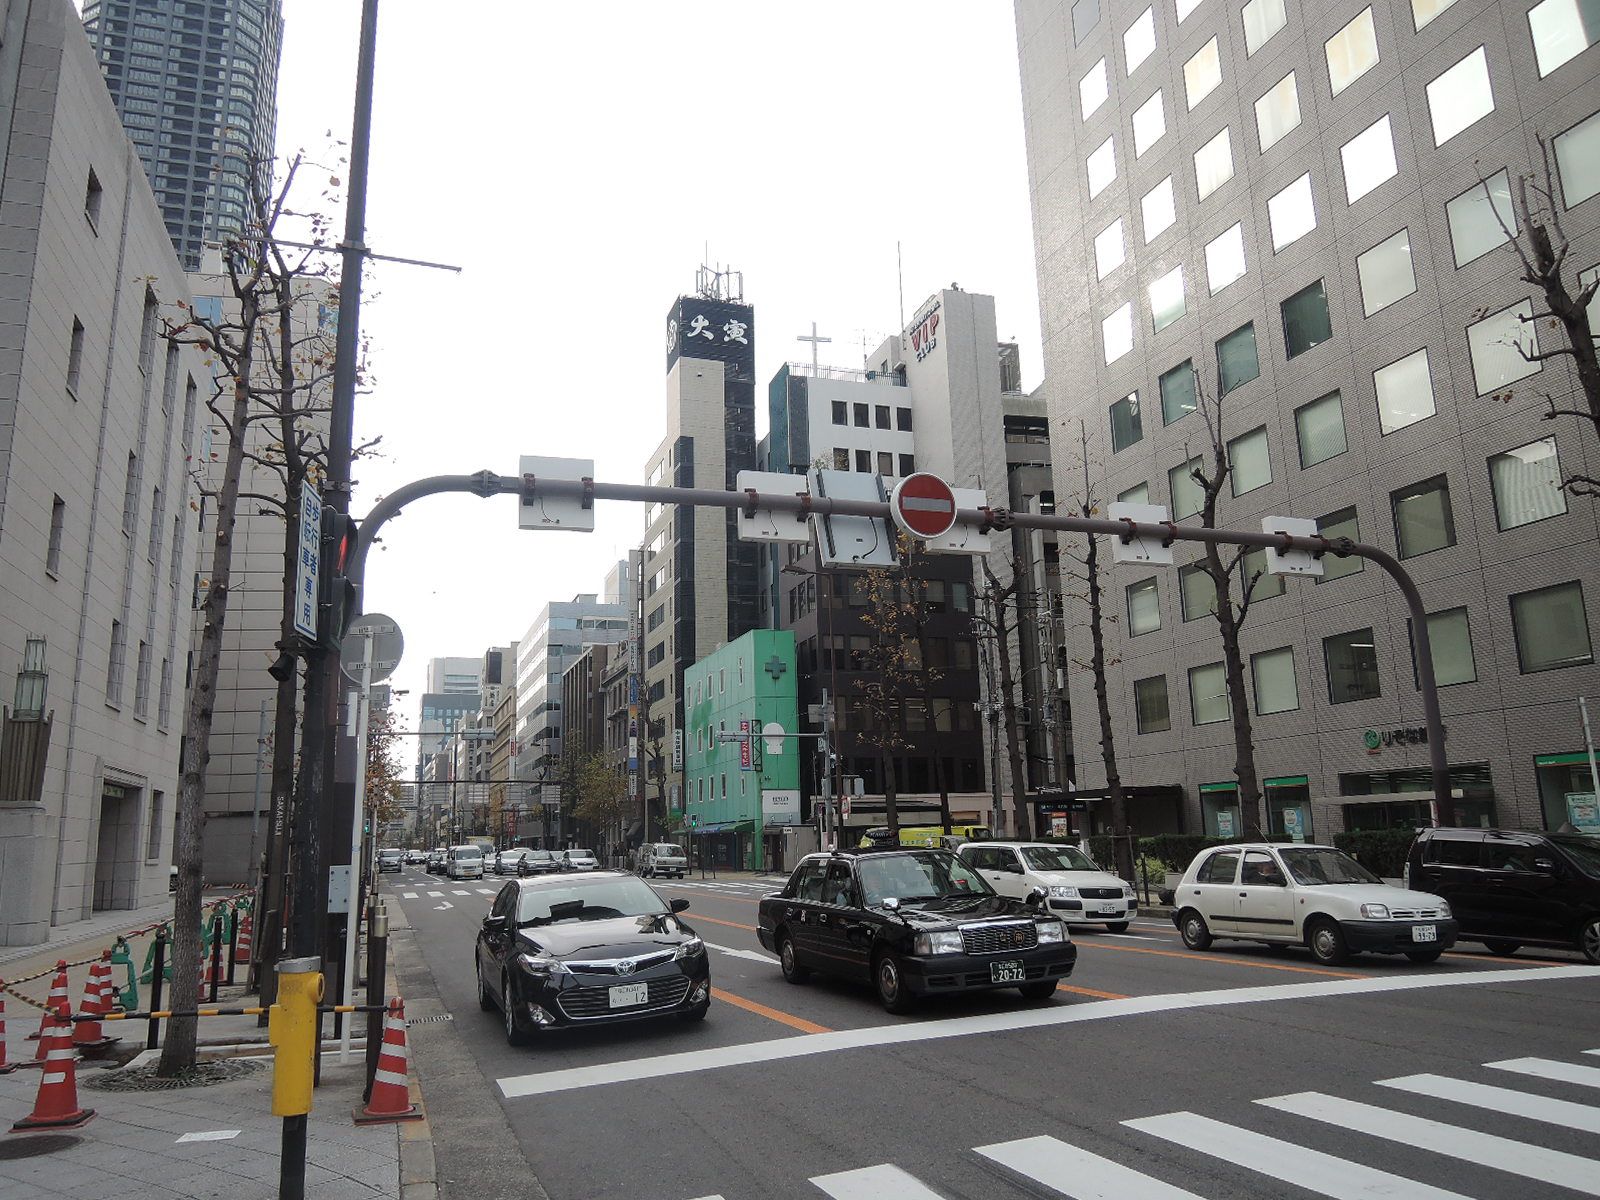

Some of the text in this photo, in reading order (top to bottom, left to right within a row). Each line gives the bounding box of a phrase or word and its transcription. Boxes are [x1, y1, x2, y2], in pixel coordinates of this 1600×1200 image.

[687, 314, 748, 345] 大寅
[912, 314, 940, 352] VIP
[916, 337, 937, 362] CLUB
[302, 497, 312, 567] 自転車
[310, 504, 319, 576] 歩行者
